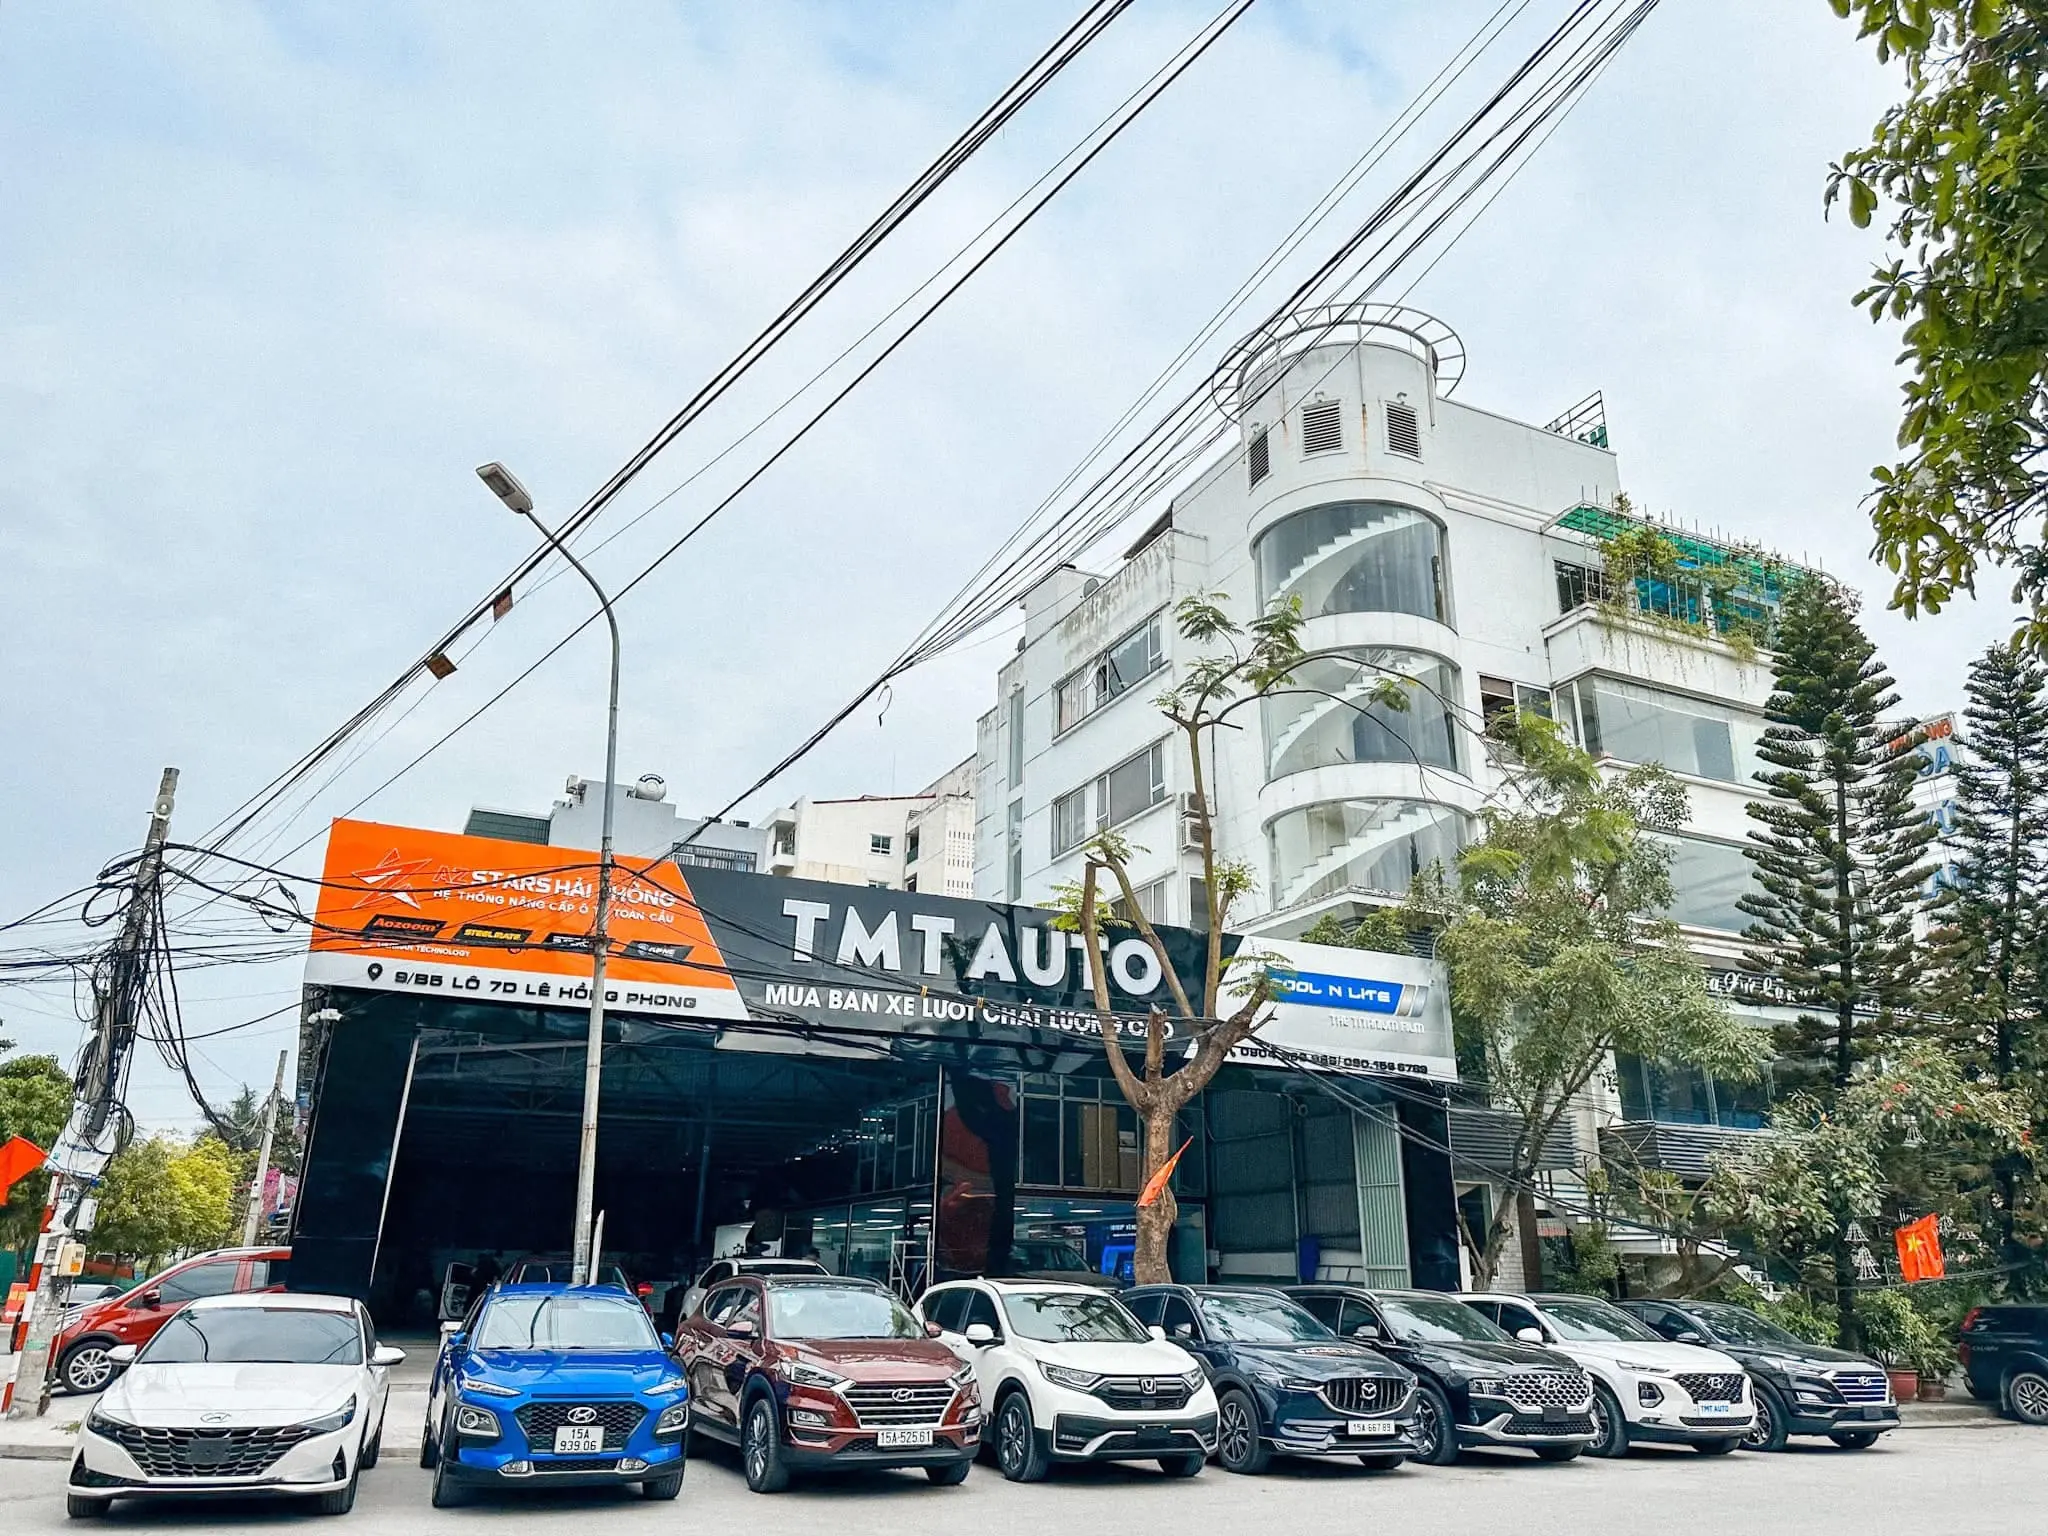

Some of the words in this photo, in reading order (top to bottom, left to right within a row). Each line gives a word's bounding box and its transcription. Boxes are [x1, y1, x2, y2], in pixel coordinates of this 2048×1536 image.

[373, 917, 436, 932] Aozoom
[415, 944, 471, 957] TECHNOLOGY
[782, 898, 956, 976] TMT
[964, 921, 1163, 996] AUTO
[452, 975, 480, 990] LÔ
[490, 980, 517, 994] 7D
[525, 982, 551, 997] LÊ
[626, 991, 697, 1009] PHONG
[1328, 984, 1342, 998] N
[1348, 987, 1391, 1003] LITE
[764, 983, 822, 1008] MUA
[885, 994, 915, 1017] XE
[1127, 1019, 1175, 1040] CO
[571, 1428, 590, 1440] 15A
